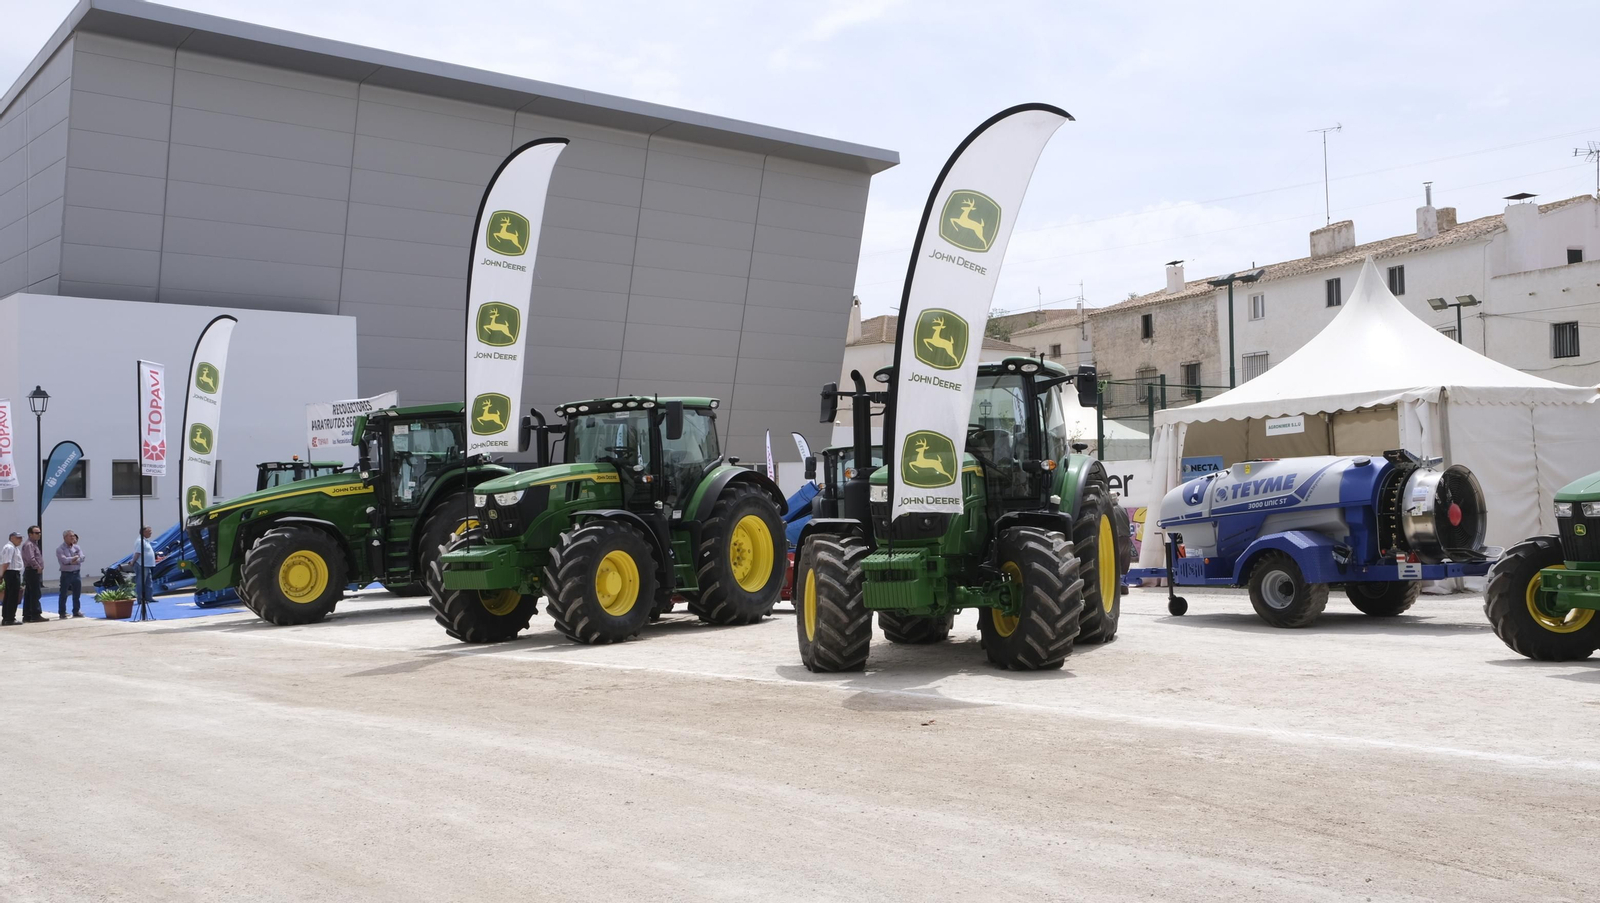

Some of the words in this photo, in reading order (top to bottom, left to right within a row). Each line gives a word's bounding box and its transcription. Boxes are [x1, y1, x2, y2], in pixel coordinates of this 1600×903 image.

[481, 258, 501, 267] JOHN
[502, 261, 526, 272] DEERE
[929, 249, 956, 264] JOHN
[956, 256, 987, 275] DEERE
[474, 351, 492, 360] JOHN
[493, 352, 517, 361] DEERE
[908, 372, 932, 384] JOHN
[932, 376, 962, 391] DEERE
[147, 369, 163, 436] TOPAVI
[332, 400, 373, 415] RECOLECTORES
[469, 443, 486, 451] JOHN
[54, 450, 77, 478] cajamar
[1231, 473, 1297, 499] TEYME
[898, 497, 924, 507] JOHN
[925, 495, 960, 505] DEERE
[1248, 502, 1263, 510] 3000
